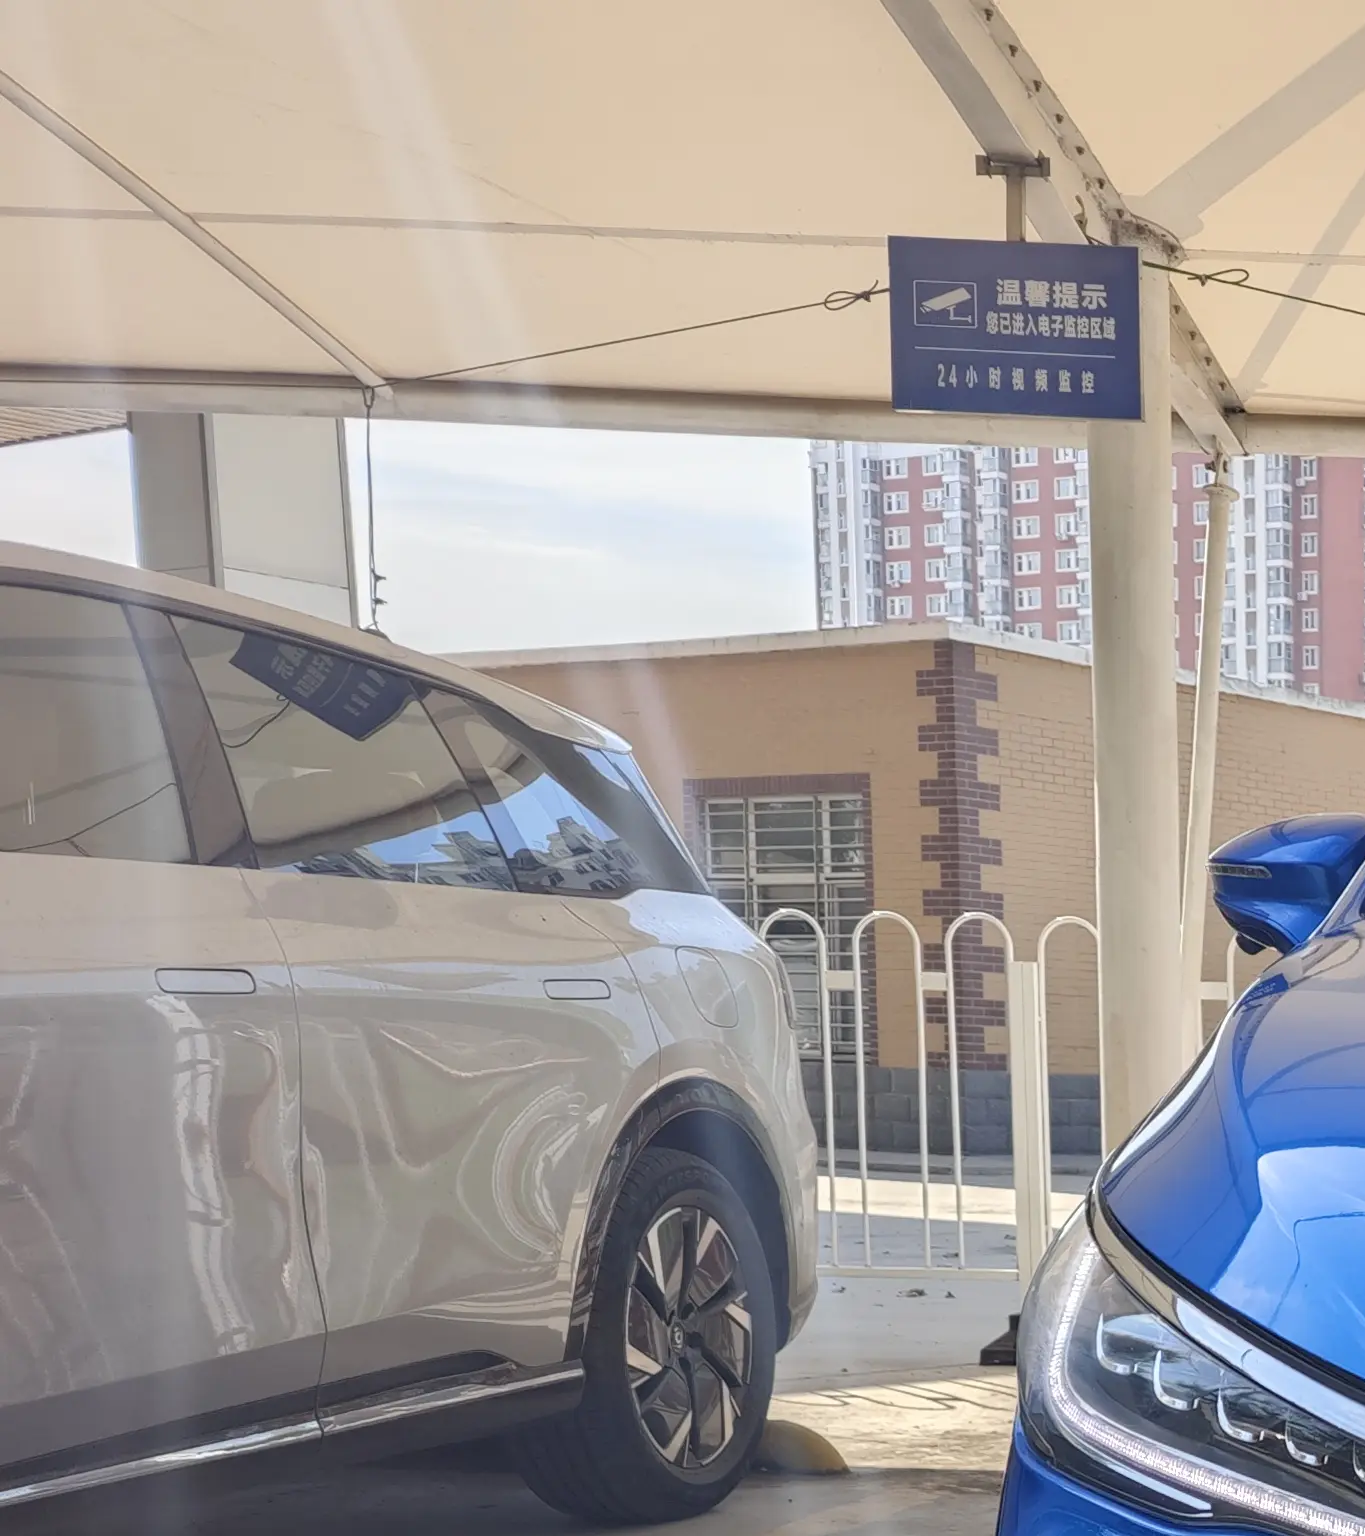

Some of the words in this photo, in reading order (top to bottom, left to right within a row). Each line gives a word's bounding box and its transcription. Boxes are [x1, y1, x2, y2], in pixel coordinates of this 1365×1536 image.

[996, 279, 1108, 309] 温馨提示
[985, 311, 1117, 341] 您已进入电子监控区域
